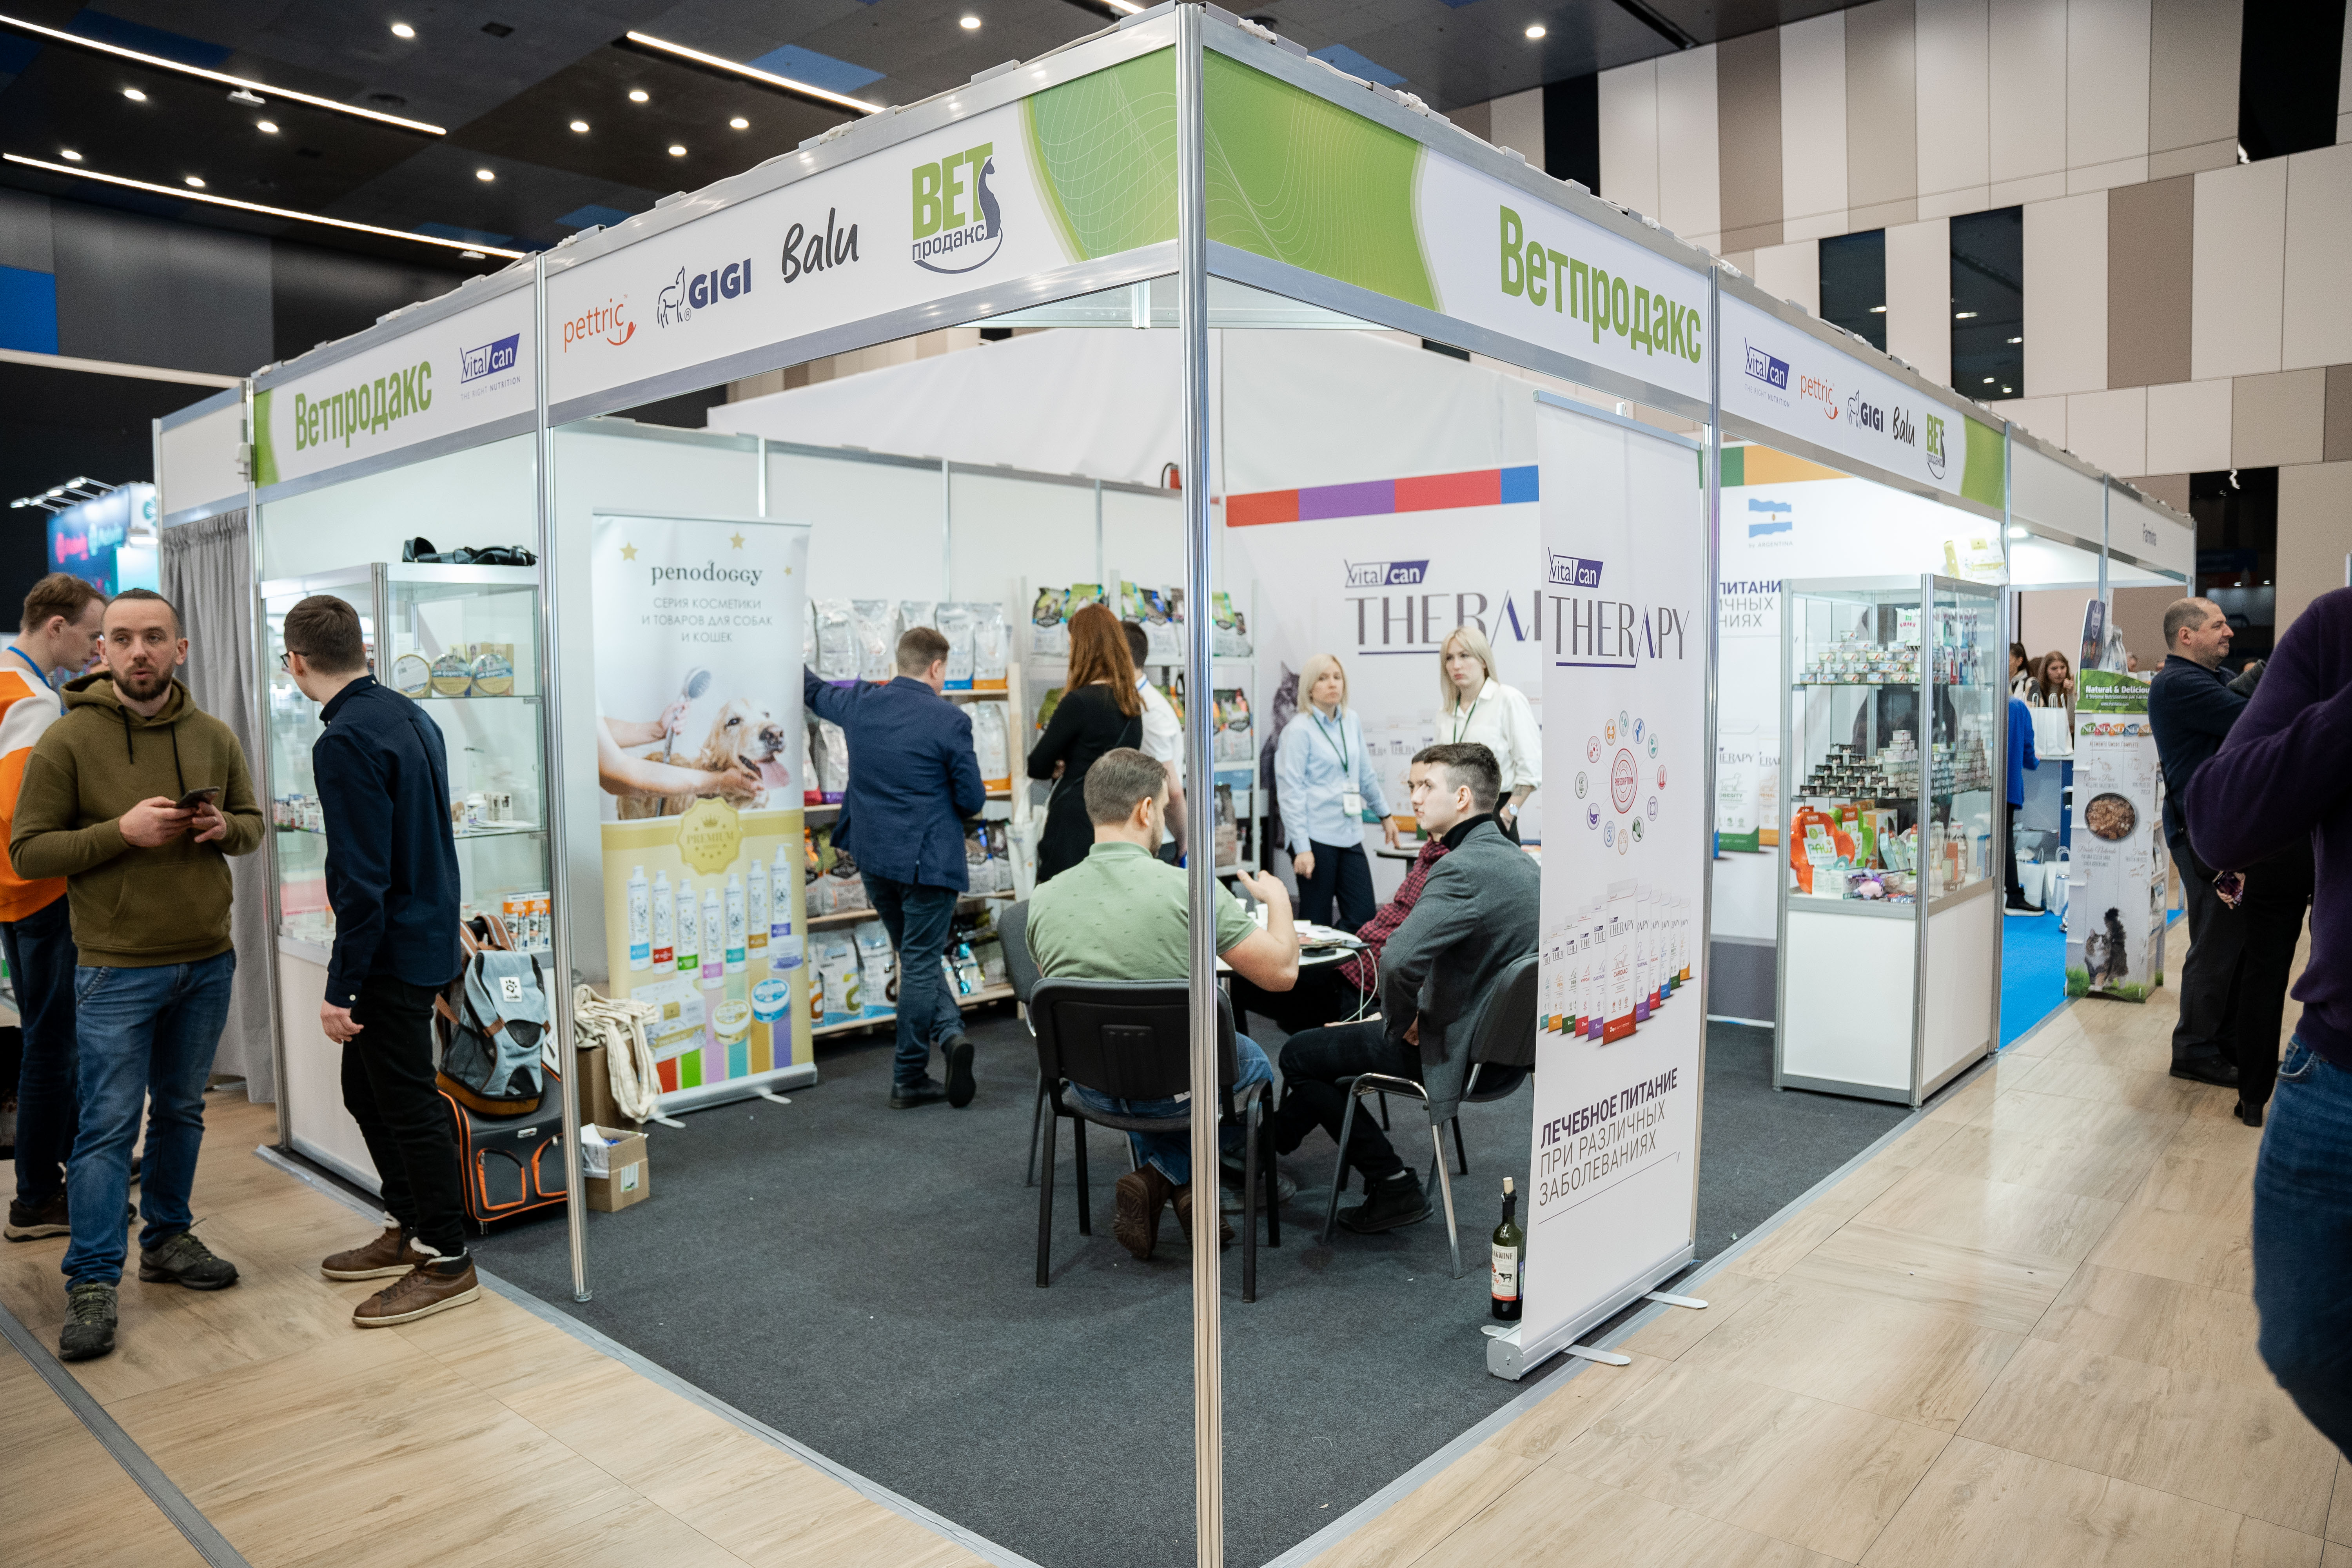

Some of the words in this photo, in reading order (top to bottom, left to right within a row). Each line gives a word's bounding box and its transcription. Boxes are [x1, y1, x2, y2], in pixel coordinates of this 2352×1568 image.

[782, 207, 859, 284] Balu
[912, 228, 985, 261] продакс
[689, 258, 752, 310] GIGI
[1499, 204, 1701, 363] Ветпродакс
[563, 298, 624, 352] pettric
[472, 387, 487, 397] RIGHT
[490, 376, 521, 392] NUTRITION
[1754, 389, 1766, 398] RIGHT
[1768, 394, 1789, 408] NUTRITION
[1801, 375, 1833, 405] pettric
[295, 360, 432, 451] Ветпродакс
[1861, 402, 1883, 432] GIGI
[1893, 407, 1915, 447] Balu
[1927, 453, 1942, 466] продакс
[1720, 581, 1781, 594] ПИТАНИ
[653, 598, 688, 608] СЕРИЯ
[693, 599, 760, 609] КОСМЕТИКИ
[1345, 590, 1541, 646] THERA
[642, 615, 650, 624] И
[654, 615, 704, 625] ТОВАРОВ
[708, 616, 730, 626] ДЛЯ
[733, 615, 772, 626] СОБАК
[1548, 596, 1690, 662] THERAPY
[682, 633, 689, 642] И
[694, 632, 732, 642] КОШЕК
[2122, 685, 2150, 693] Deliciou
[1615, 777, 1633, 786] PRESCRIPTION
[687, 831, 733, 844] PREMIUM
[1609, 919, 1634, 935] THERAPY
[1613, 968, 1628, 977] CARDIAC
[1541, 1094, 1617, 1149] ЛЕЧЕБНОЕ
[1621, 1067, 1677, 1112] ПИТАНИЕ
[1541, 1142, 1573, 1178] ПРИ
[1579, 1099, 1665, 1160] РАЗЛИЧНЫХ
[1540, 1129, 1656, 1206] ЗАБОЛЕВАНИЯХ
